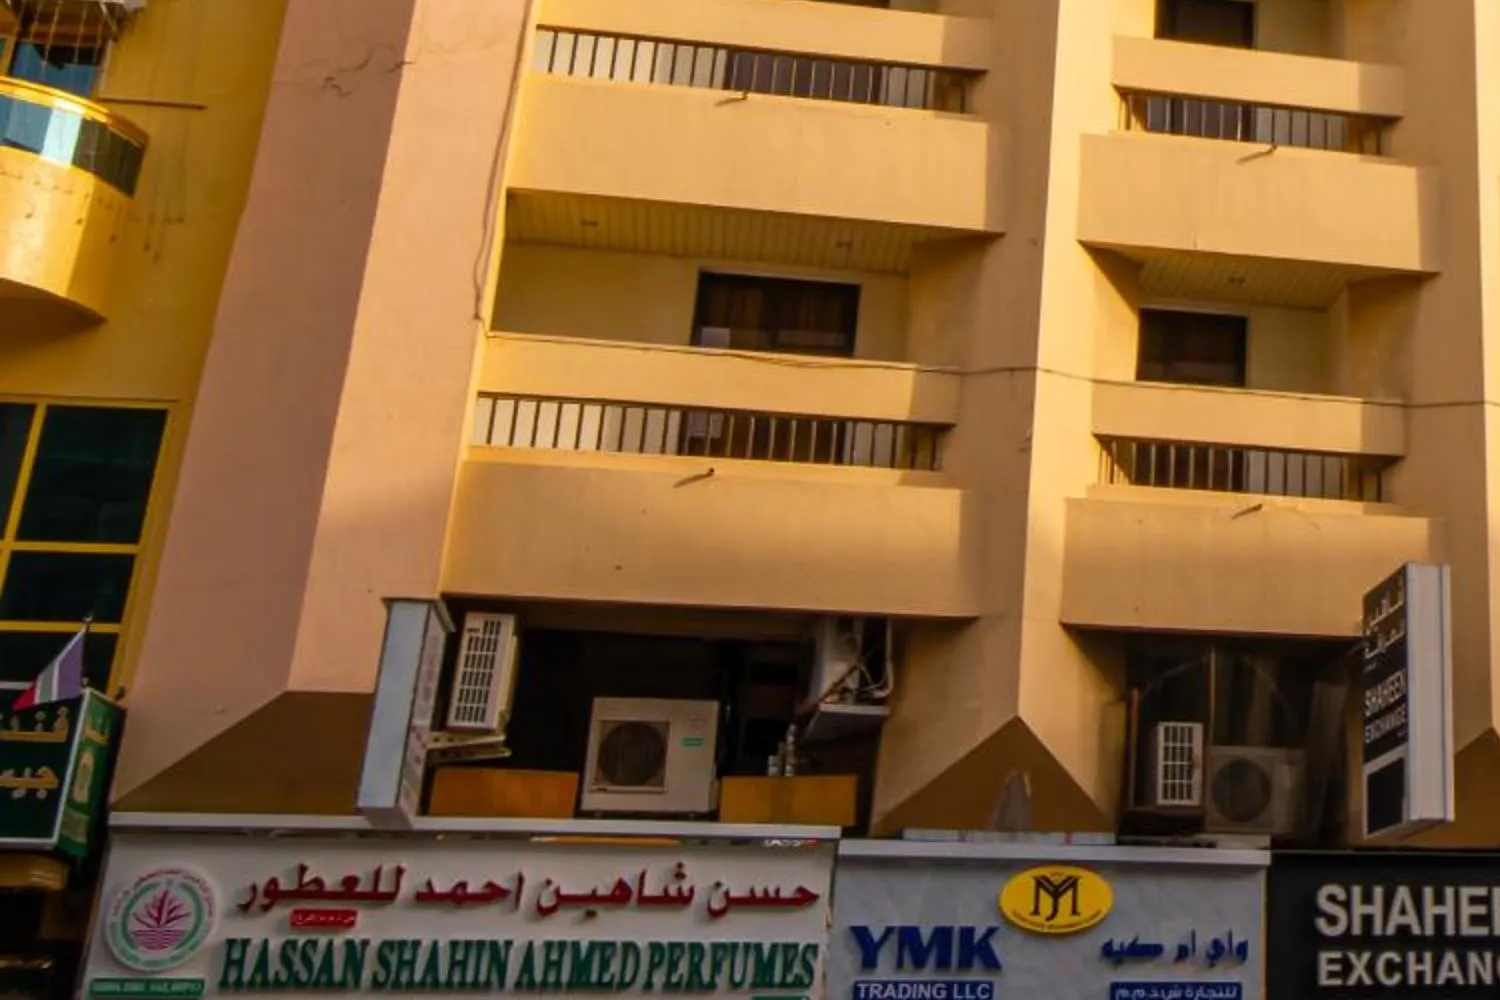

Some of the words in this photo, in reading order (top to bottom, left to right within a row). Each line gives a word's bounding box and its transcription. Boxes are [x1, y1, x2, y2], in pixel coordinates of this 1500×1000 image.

[237, 863, 405, 912] للعطور
[536, 861, 695, 919] شاهين
[707, 879, 820, 917] حسن
[218, 938, 369, 991] HASSAN
[370, 938, 513, 991] SHAHIN
[514, 939, 641, 991] AHMED
[642, 941, 819, 991] PERFUMES
[849, 925, 1002, 970] YMK
[856, 983, 948, 1000] TRADING
[952, 983, 991, 1000] LLC
